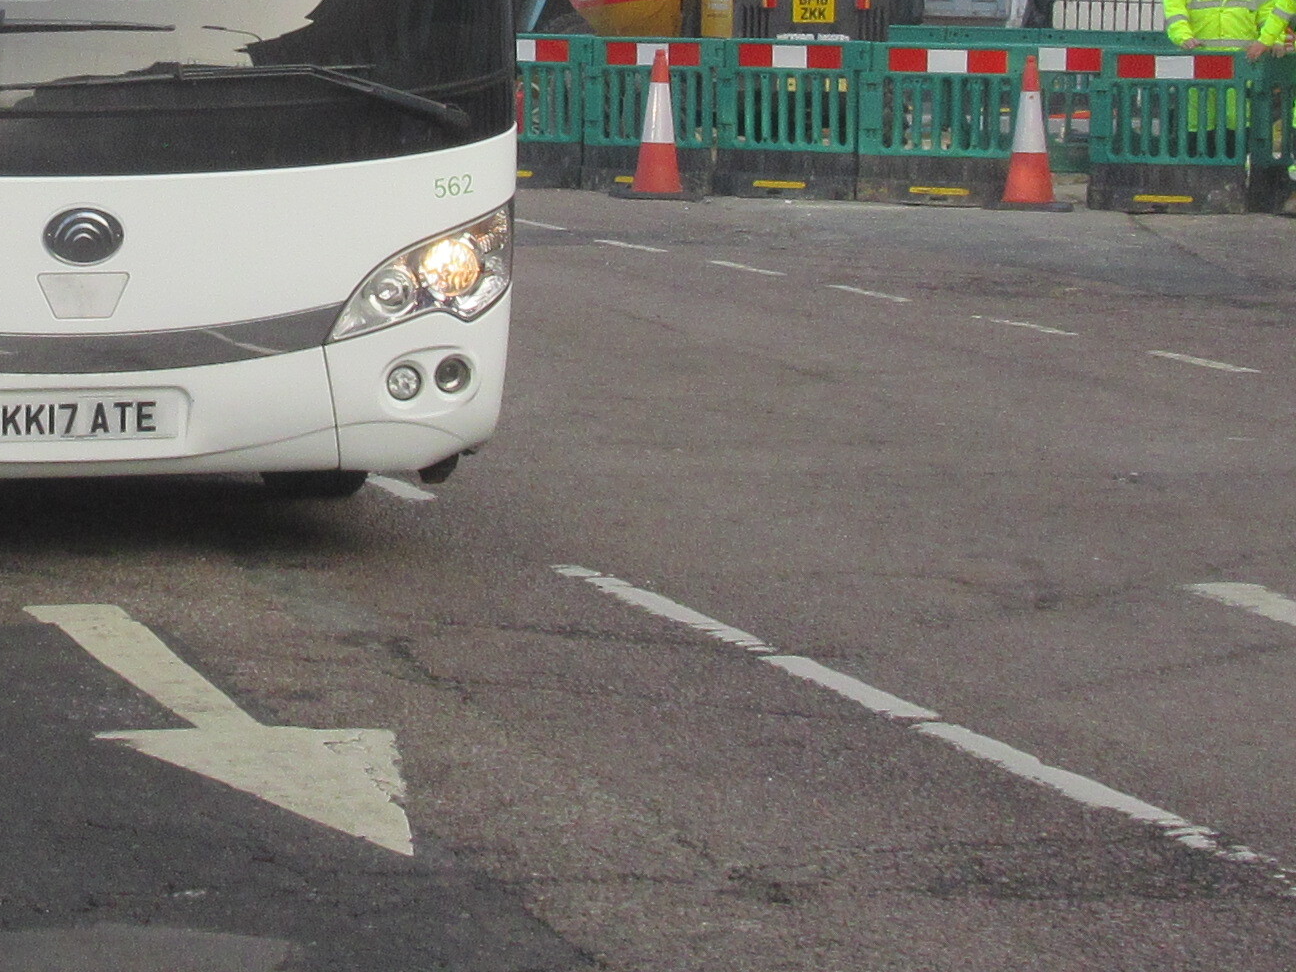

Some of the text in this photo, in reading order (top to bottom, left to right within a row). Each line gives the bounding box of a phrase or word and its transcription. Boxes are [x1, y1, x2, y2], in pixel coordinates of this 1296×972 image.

[800, 7, 826, 20] ZKK
[434, 173, 474, 199] 562
[1, 401, 157, 436] KK17 ATE
